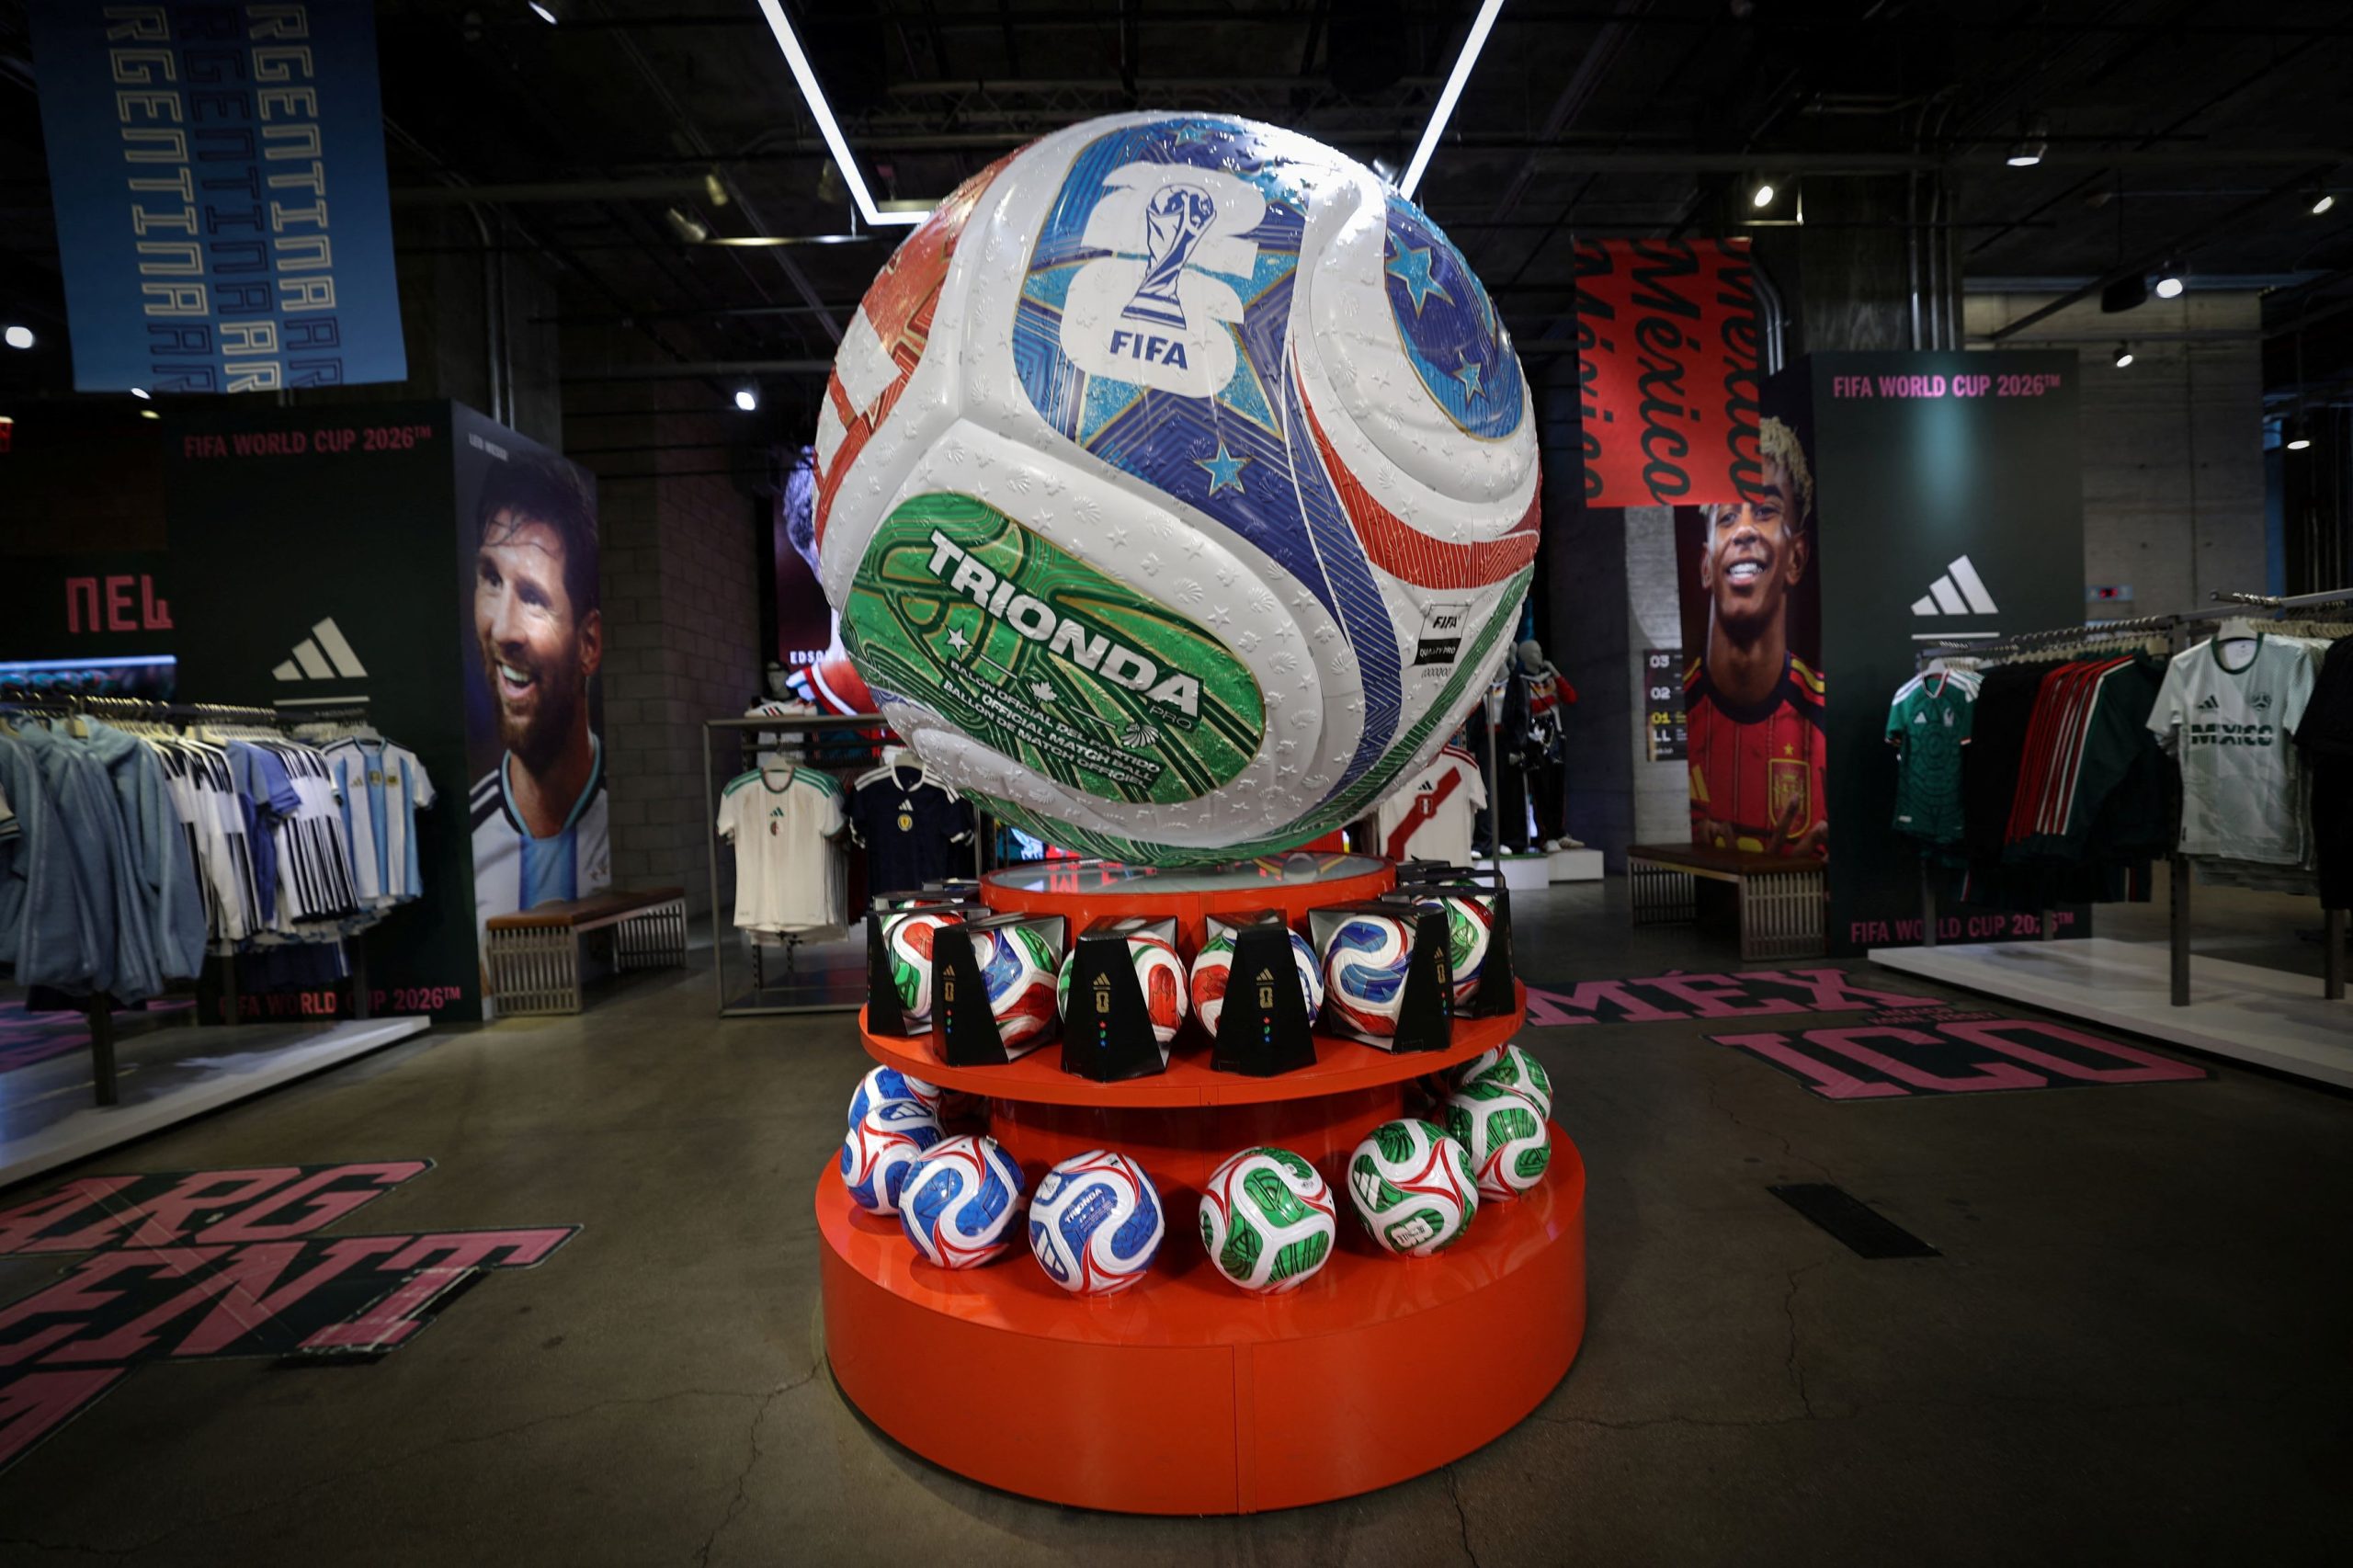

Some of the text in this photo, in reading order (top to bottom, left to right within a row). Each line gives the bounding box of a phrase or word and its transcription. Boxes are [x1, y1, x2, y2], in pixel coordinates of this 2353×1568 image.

[1109, 329, 1188, 370] FIFA
[1631, 237, 1701, 506] México
[1833, 375, 1873, 398] FIFA
[1878, 374, 1947, 398] WORLD
[1951, 374, 1991, 397] CUP
[184, 433, 228, 459] FIFA
[232, 431, 307, 457] WORLD
[313, 427, 357, 453] CUP
[928, 528, 1201, 718] TRIONDA
[1432, 616, 1458, 630] FIFA
[1650, 686, 1671, 700] 02
[997, 689, 1054, 729] OFICIAL
[1056, 722, 1086, 743] DEL
[1089, 738, 1161, 773] PARTIDO
[1150, 704, 1193, 730] PRO
[1652, 711, 1672, 725] 01
[943, 679, 1147, 790] BALLON DE MATCH OFFICIEL
[982, 693, 1153, 782] OFFICIAL MATCH BALL
[2191, 723, 2273, 746] MEXICO
[1850, 920, 1891, 943] FIFA
[1894, 916, 1962, 942] WOLD
[1968, 915, 2006, 937] CUP
[219, 994, 261, 1016] FFA
[265, 991, 338, 1016] WORLD
[1709, 1019, 2207, 1099] ICO
